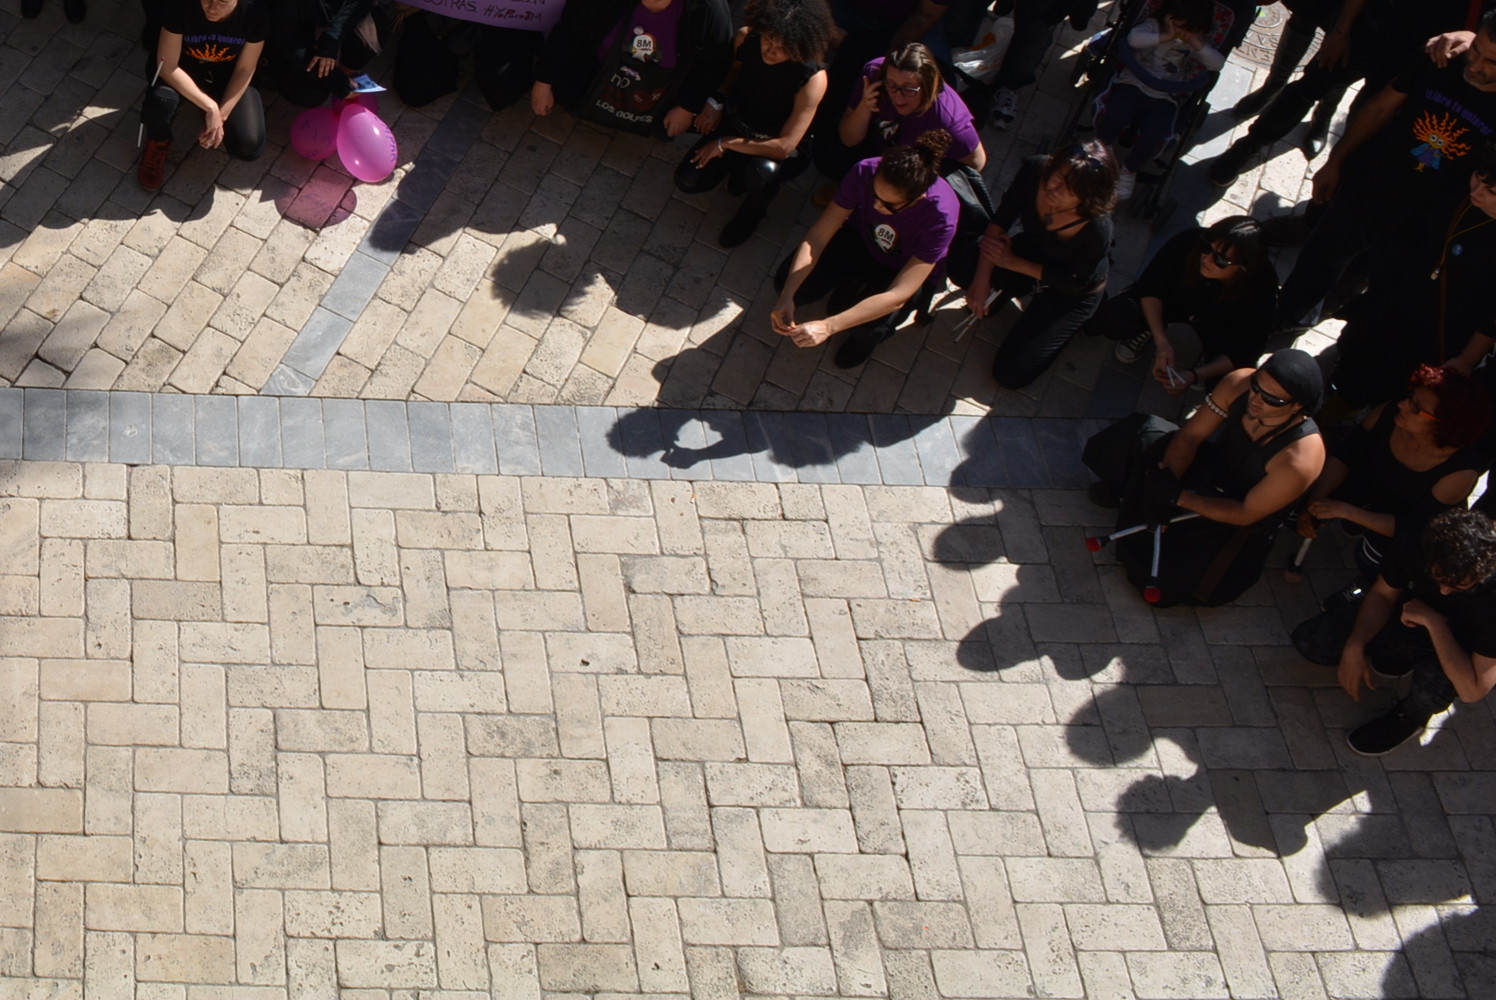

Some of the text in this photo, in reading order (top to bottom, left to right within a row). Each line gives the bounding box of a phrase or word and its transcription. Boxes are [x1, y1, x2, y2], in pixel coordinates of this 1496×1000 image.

[636, 39, 652, 48] 8M
[610, 73, 631, 89] no
[595, 99, 616, 113] LOS
[878, 228, 894, 242] 8M
